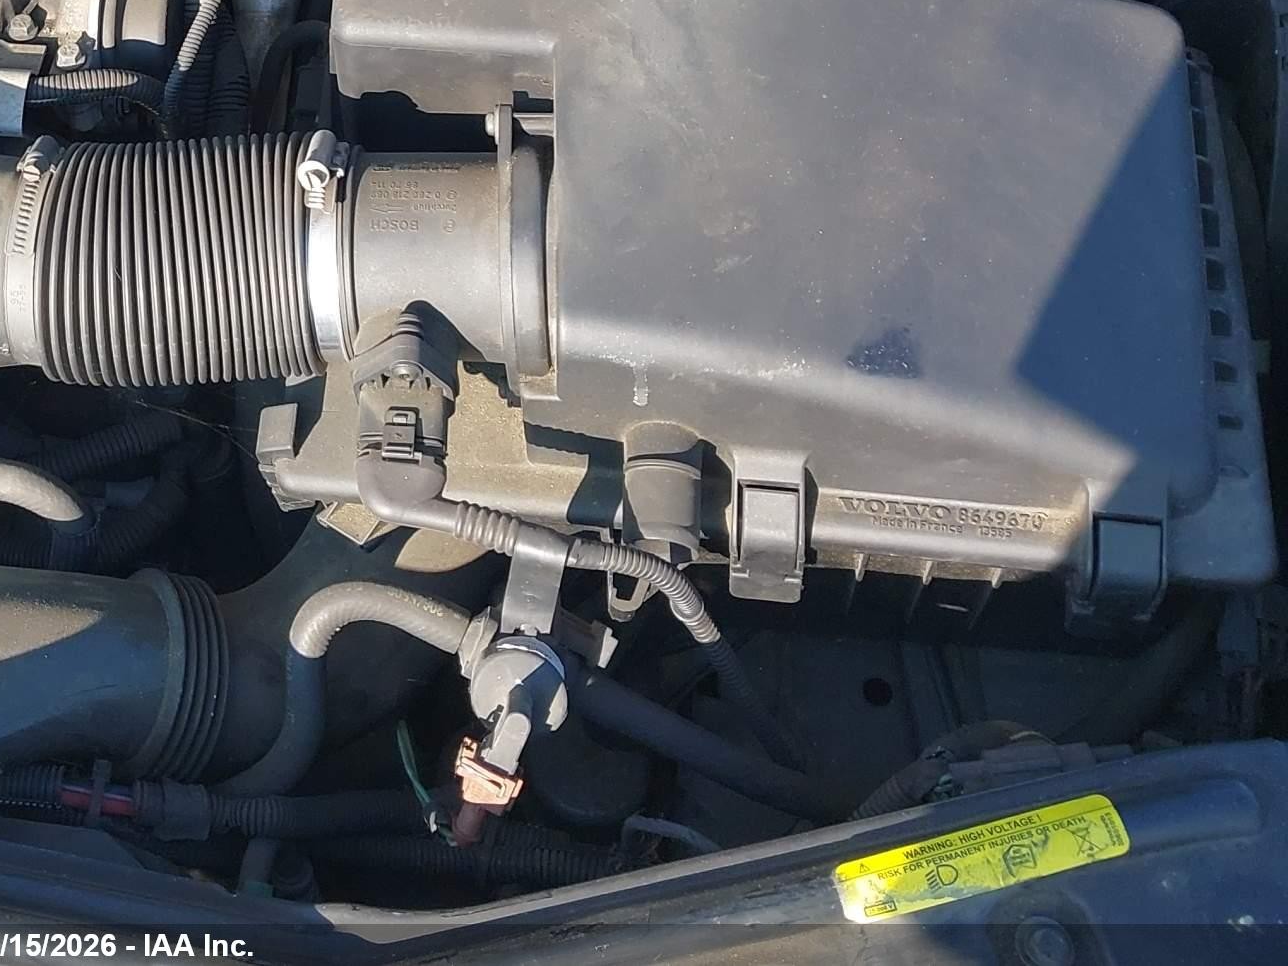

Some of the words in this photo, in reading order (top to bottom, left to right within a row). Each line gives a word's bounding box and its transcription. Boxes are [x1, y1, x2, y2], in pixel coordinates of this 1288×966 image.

[369, 218, 420, 234] BOSCH
[838, 496, 953, 520] VOLVO
[957, 507, 1049, 531] 8649670
[872, 515, 902, 527] Made
[904, 518, 917, 529] in
[919, 520, 963, 533] France
[877, 868, 903, 881] RISK
[902, 862, 924, 875] FOR
[924, 843, 987, 869] PERMANENT
[987, 831, 1034, 850] INJURIES
[1034, 825, 1051, 837] OR
[1051, 815, 1087, 834] DEATH
[902, 836, 959, 861] WARNING:
[959, 830, 987, 846] HIGH
[986, 817, 1036, 838] VOLTAGE
